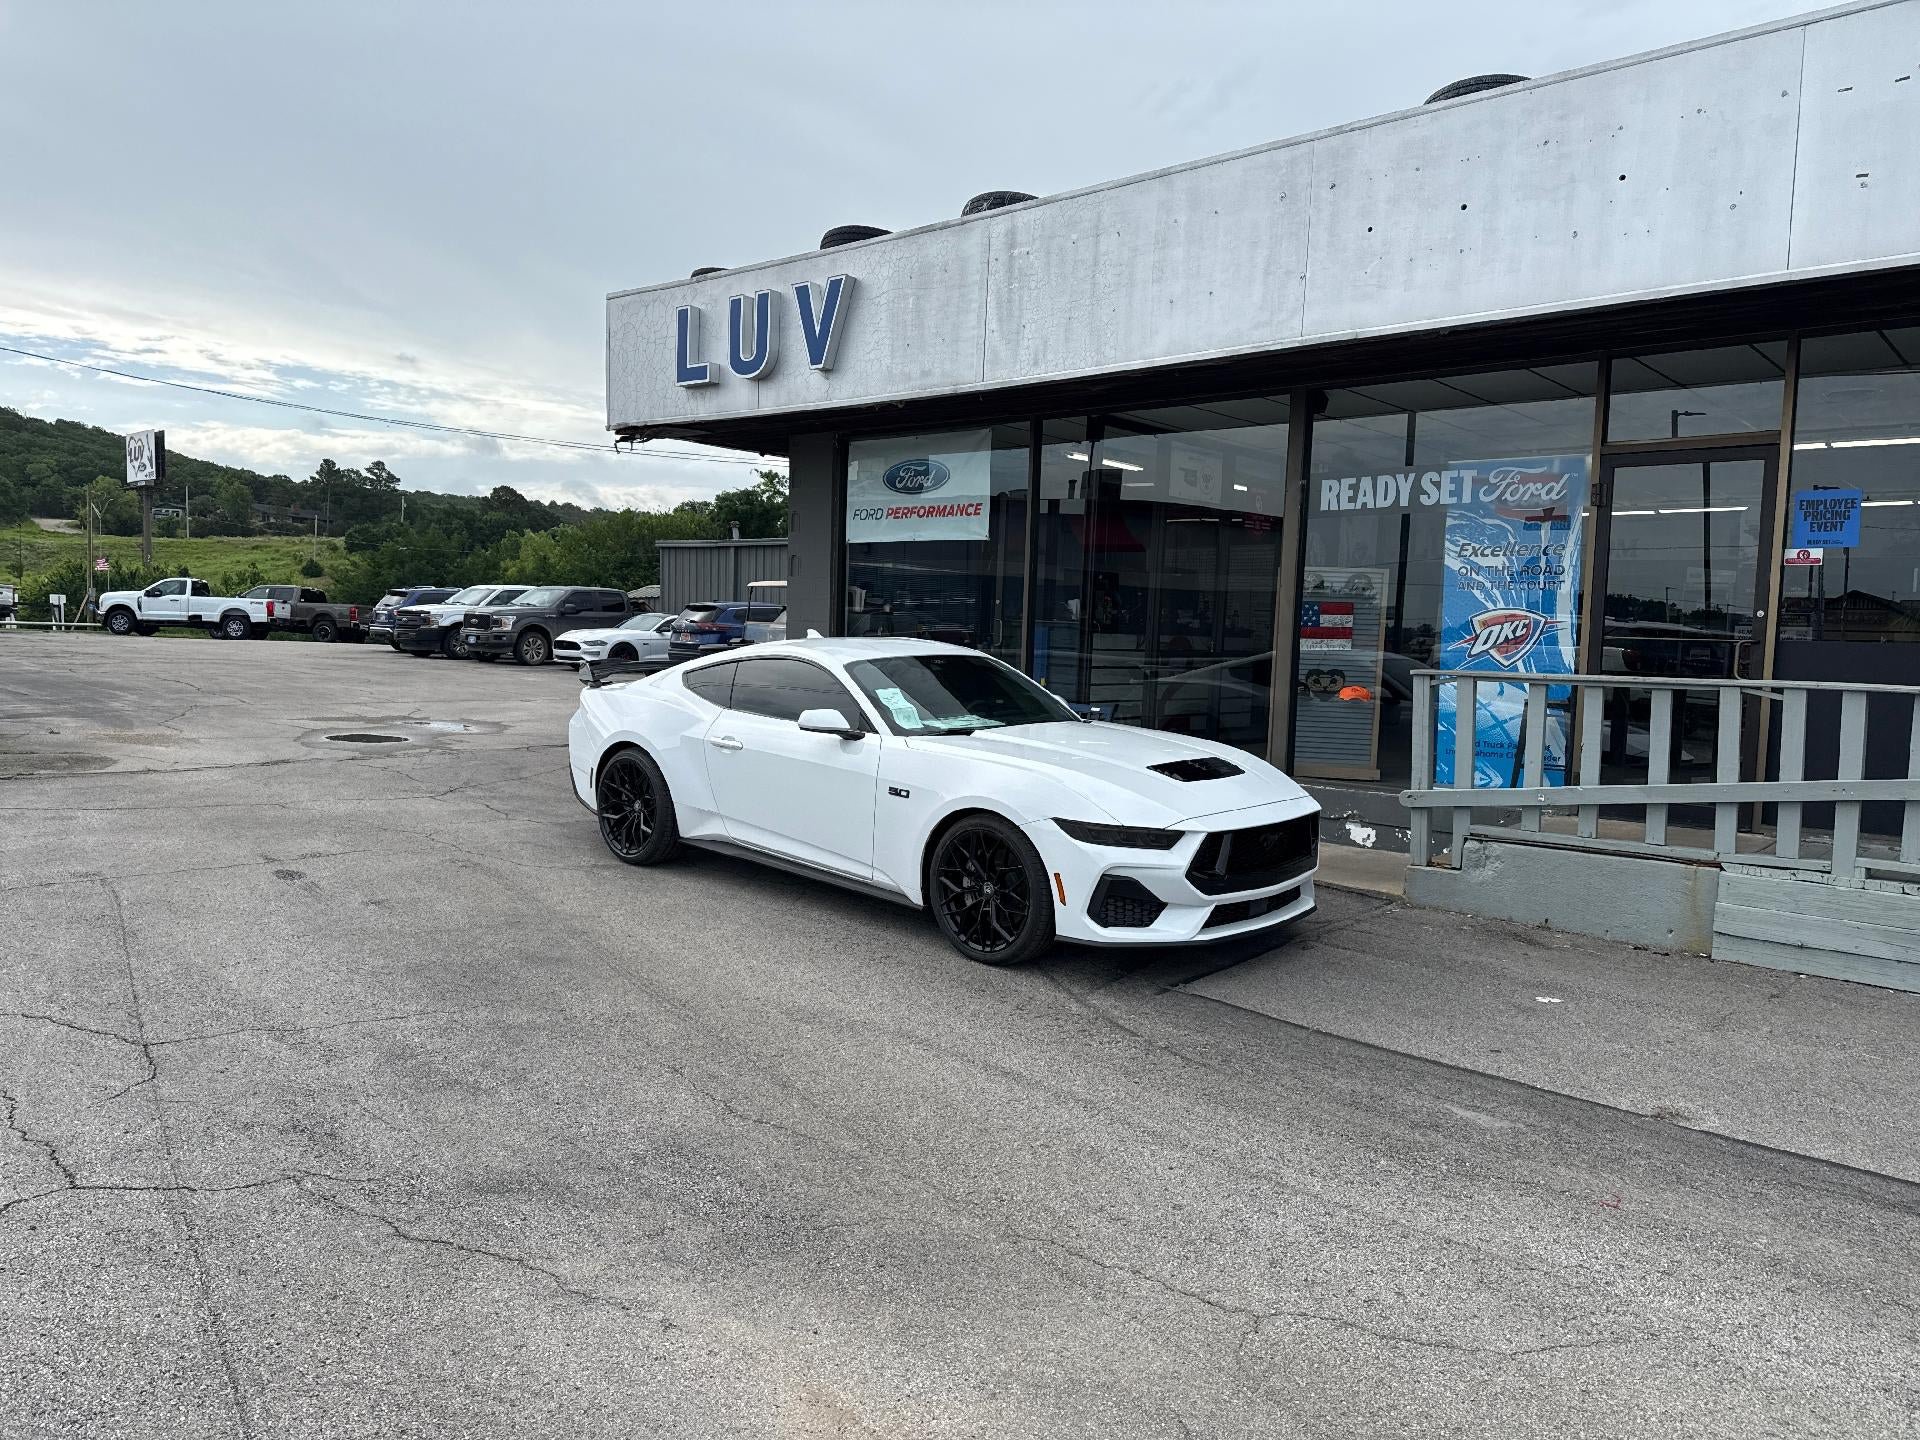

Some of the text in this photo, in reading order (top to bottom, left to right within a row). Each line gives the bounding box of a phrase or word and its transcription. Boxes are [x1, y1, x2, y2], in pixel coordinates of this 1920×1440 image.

[676, 274, 856, 387] LUV
[895, 465, 936, 488] Ford
[1320, 472, 1416, 511] READY
[1419, 469, 1478, 506] SET
[1479, 467, 1570, 501] Ford
[853, 503, 983, 520] FORD PERFORMANCE
[1799, 498, 1858, 510] EMPLOYEE
[1803, 510, 1851, 521] PRICING
[1809, 521, 1845, 532] EVENT
[1457, 541, 1566, 558] Excellence
[1458, 564, 1566, 577] ON THE ROAD
[1458, 580, 1566, 591] AND THE COURT
[1470, 619, 1530, 655] OKC
